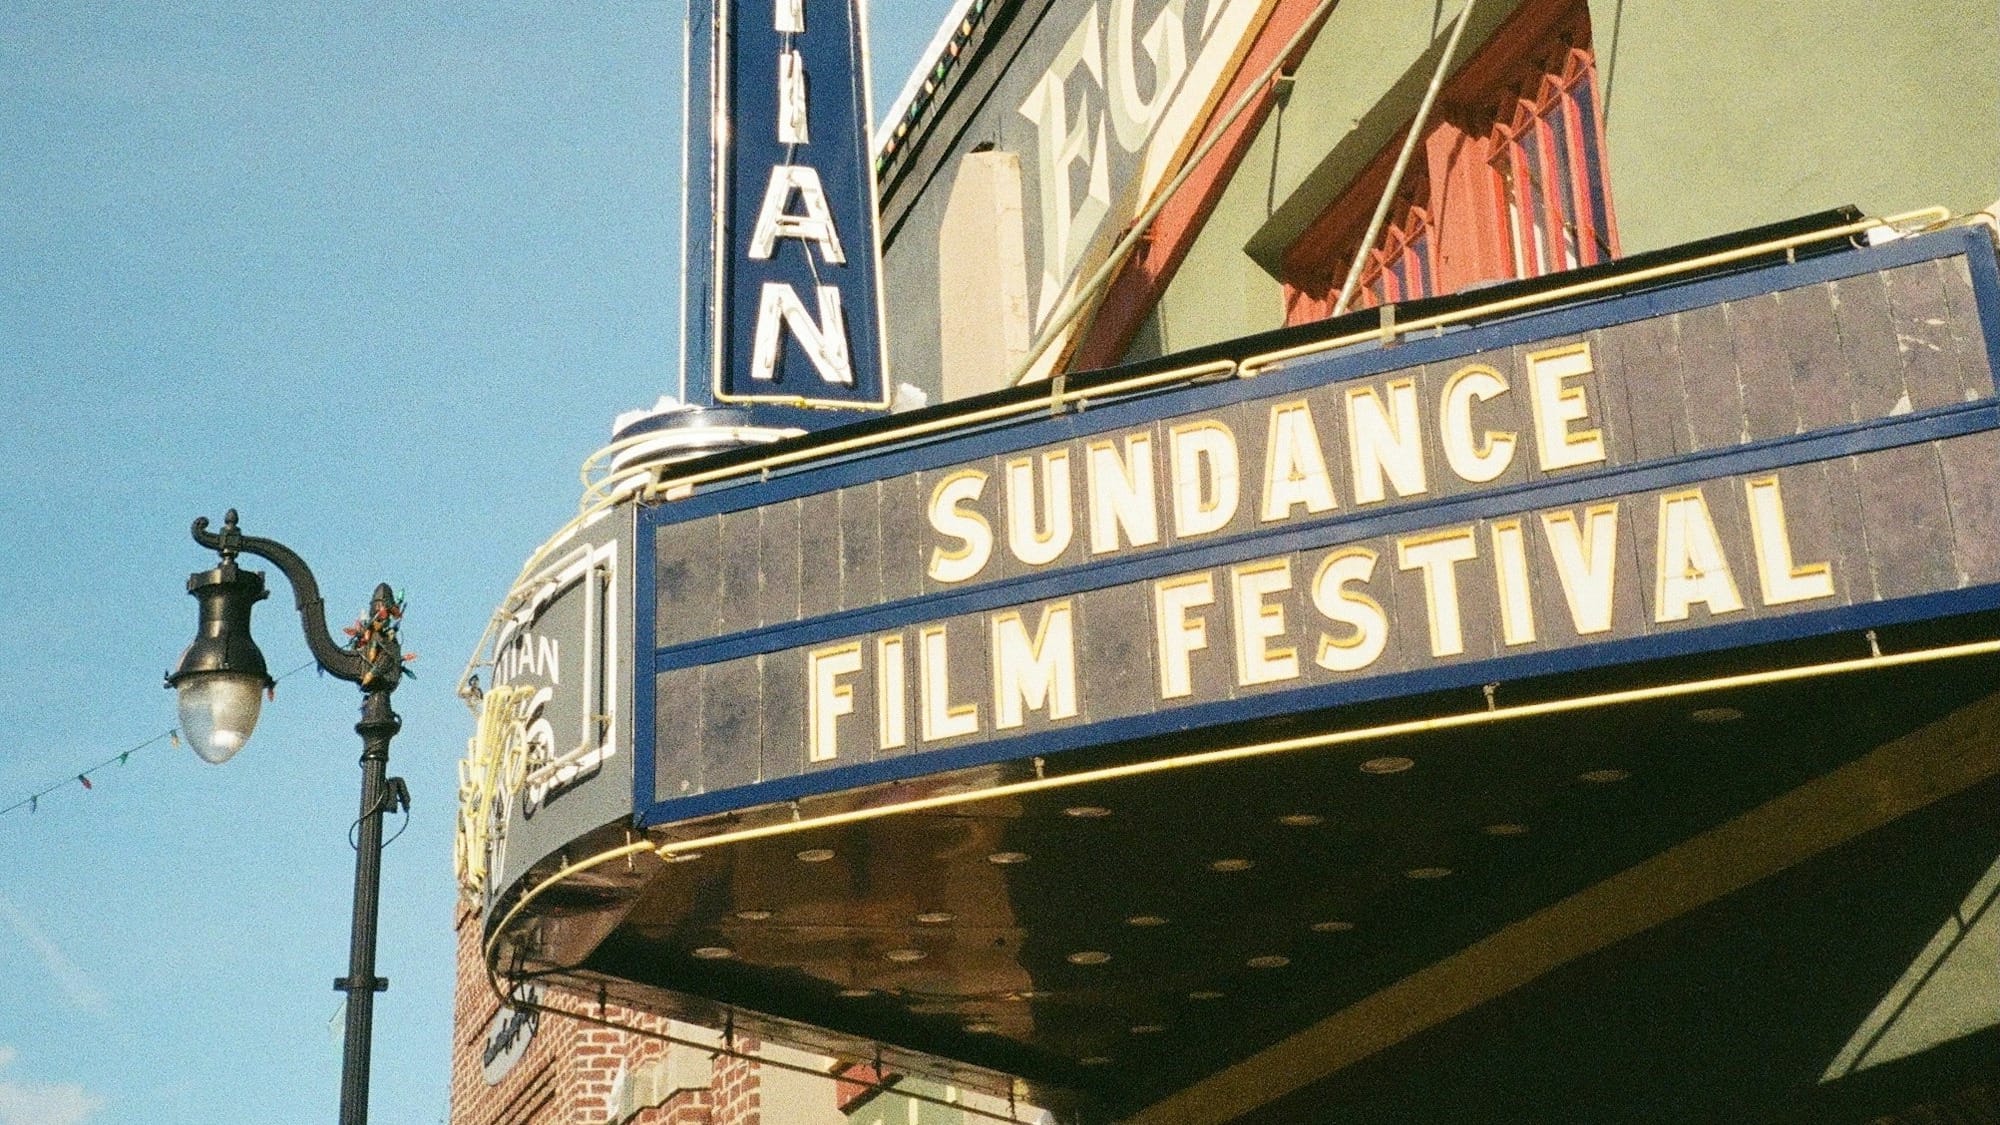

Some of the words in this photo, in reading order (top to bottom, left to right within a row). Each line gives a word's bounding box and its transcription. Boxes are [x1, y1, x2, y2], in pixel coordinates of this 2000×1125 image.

[1017, 0, 1209, 336] EG
[928, 341, 1606, 583] SUNDANCE
[808, 600, 1078, 763] FILM
[1154, 474, 1835, 700] FESTIVAL
